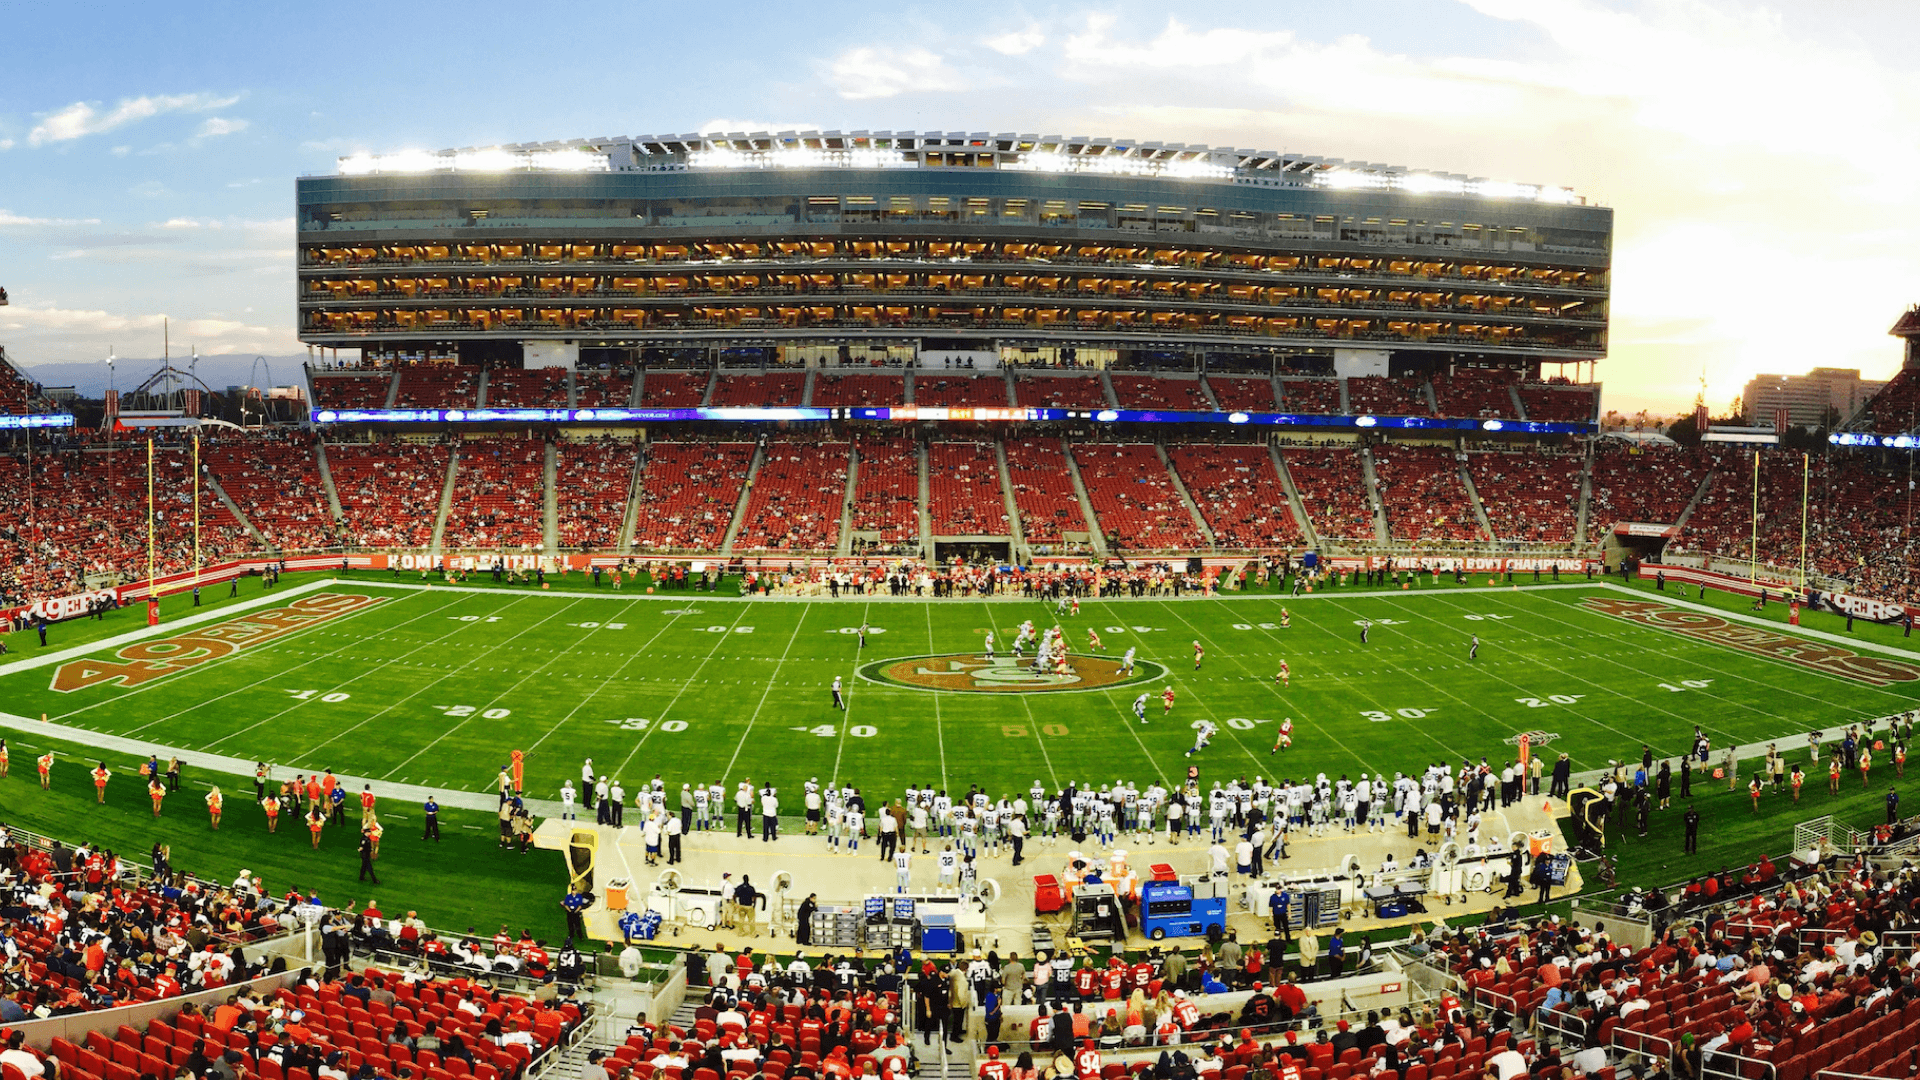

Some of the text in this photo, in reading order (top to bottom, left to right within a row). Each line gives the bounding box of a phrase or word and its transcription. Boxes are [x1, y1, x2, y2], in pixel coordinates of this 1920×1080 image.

[387, 555, 444, 569] HOME
[480, 555, 573, 570] FAITHL
[1506, 558, 1582, 571] CHAMPIONS
[49, 593, 393, 693] 49ERS
[1573, 596, 1920, 686] 49ERS
[1657, 678, 1709, 693] 10
[290, 689, 350, 702] 10
[1514, 694, 1578, 707] 20
[444, 705, 511, 719] 20
[1359, 707, 1428, 722] 30
[620, 718, 689, 732] 30
[809, 724, 878, 737] 40
[1001, 723, 1070, 737] 50
[898, 858, 905, 868] 11
[942, 856, 953, 866] 32
[560, 954, 576, 967] 54
[974, 968, 985, 981] 24
[158, 986, 165, 998] 7
[1181, 1006, 1199, 1026] 16
[1080, 1054, 1101, 1075] 94
